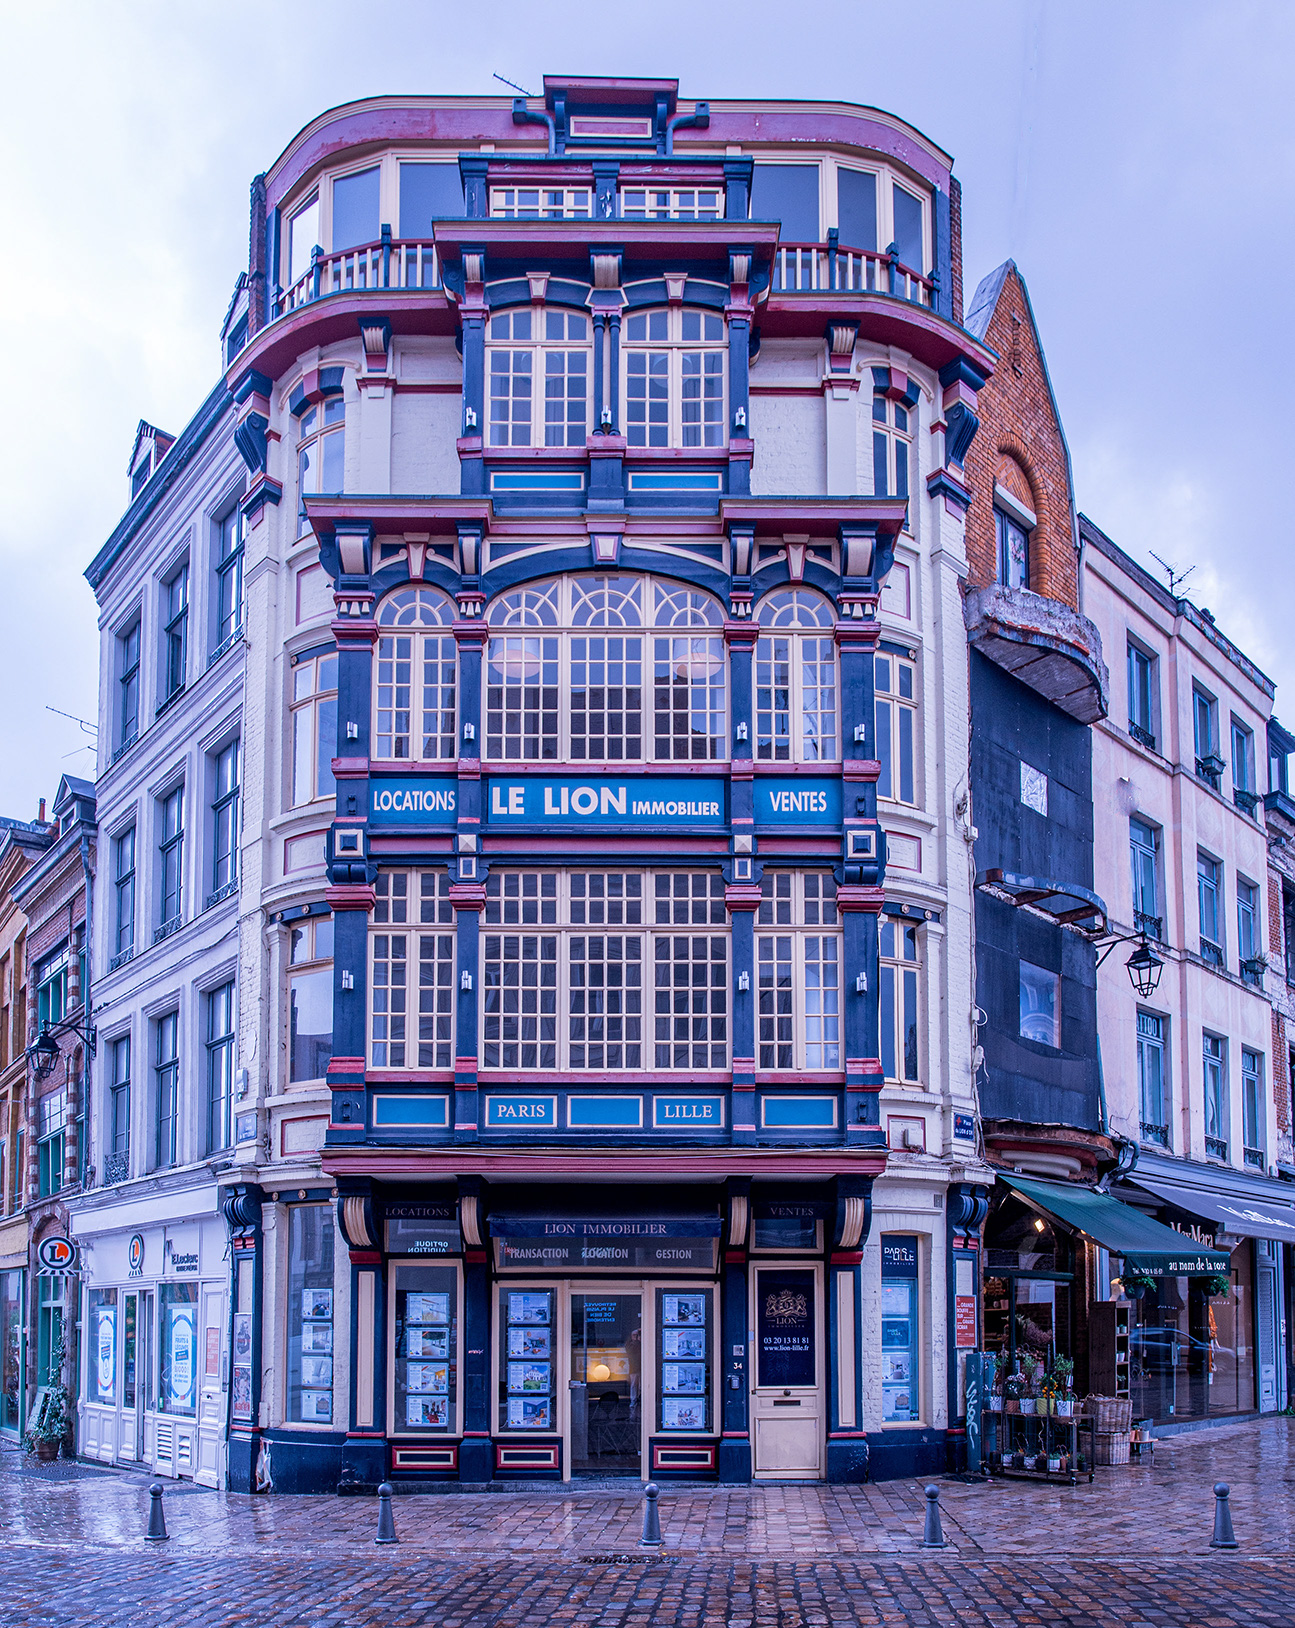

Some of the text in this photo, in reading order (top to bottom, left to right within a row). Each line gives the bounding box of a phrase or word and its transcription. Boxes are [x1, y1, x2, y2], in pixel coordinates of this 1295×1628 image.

[373, 790, 456, 812] LOCATIONS
[492, 786, 720, 816] LE LION IMMOBILIER
[769, 791, 827, 812] VENTES
[497, 1105, 546, 1118] PARIS
[664, 1105, 713, 1118] LILLE
[385, 1207, 450, 1216] LOCATIONS
[770, 1207, 814, 1216] VENTES
[544, 1223, 667, 1234] LION IMMOBILIER
[171, 1253, 198, 1265] E.Leclerc
[510, 1248, 569, 1259] TRANSACTION
[584, 1248, 629, 1259] LOCATION
[655, 1249, 692, 1259] GESTION
[893, 1253, 915, 1261] LILLE
[1168, 1262, 1178, 1271] au
[1179, 1262, 1196, 1271] nom
[1196, 1257, 1205, 1271] de
[1205, 1257, 1213, 1271] la
[776, 1317, 798, 1325] LION
[733, 1362, 743, 1370] 34
